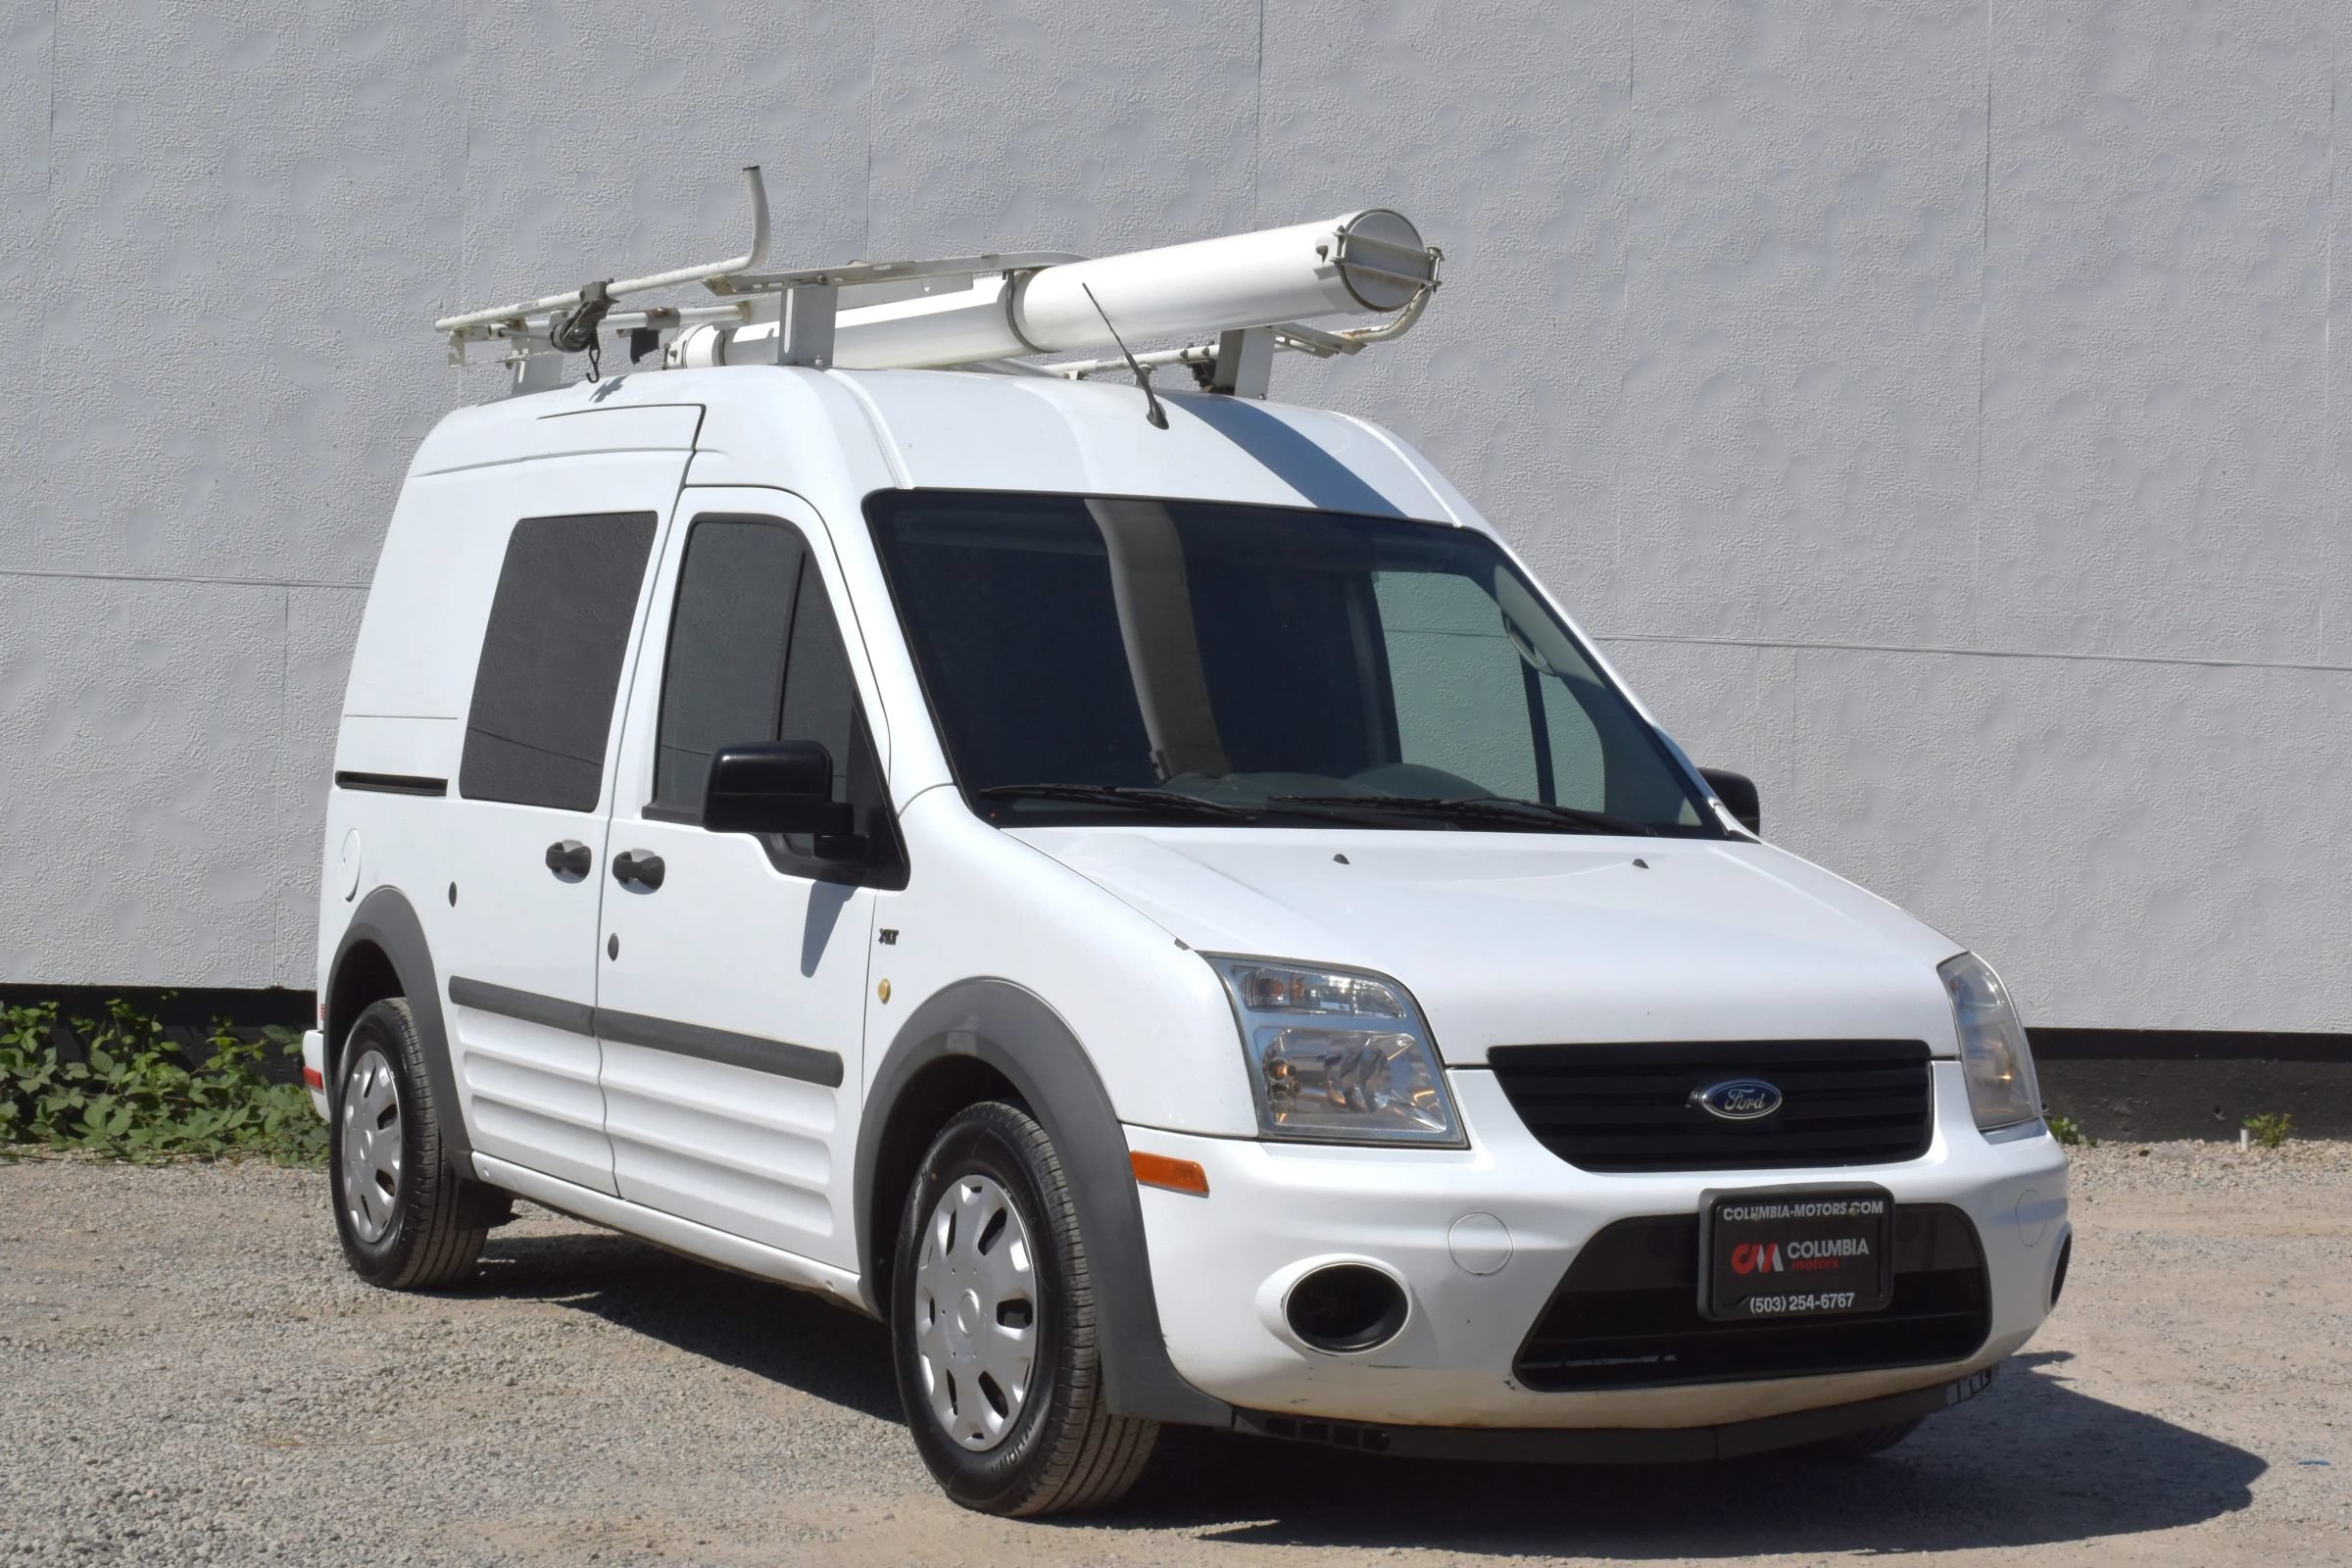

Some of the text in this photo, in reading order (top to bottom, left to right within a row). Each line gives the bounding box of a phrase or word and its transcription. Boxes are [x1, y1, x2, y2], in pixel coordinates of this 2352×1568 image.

[1725, 1088, 1765, 1110] Ford
[1787, 1238, 1870, 1259] COLUMBIA
[1790, 1257, 1839, 1271] motors
[1749, 1292, 1855, 1314] (503) 254-6767
